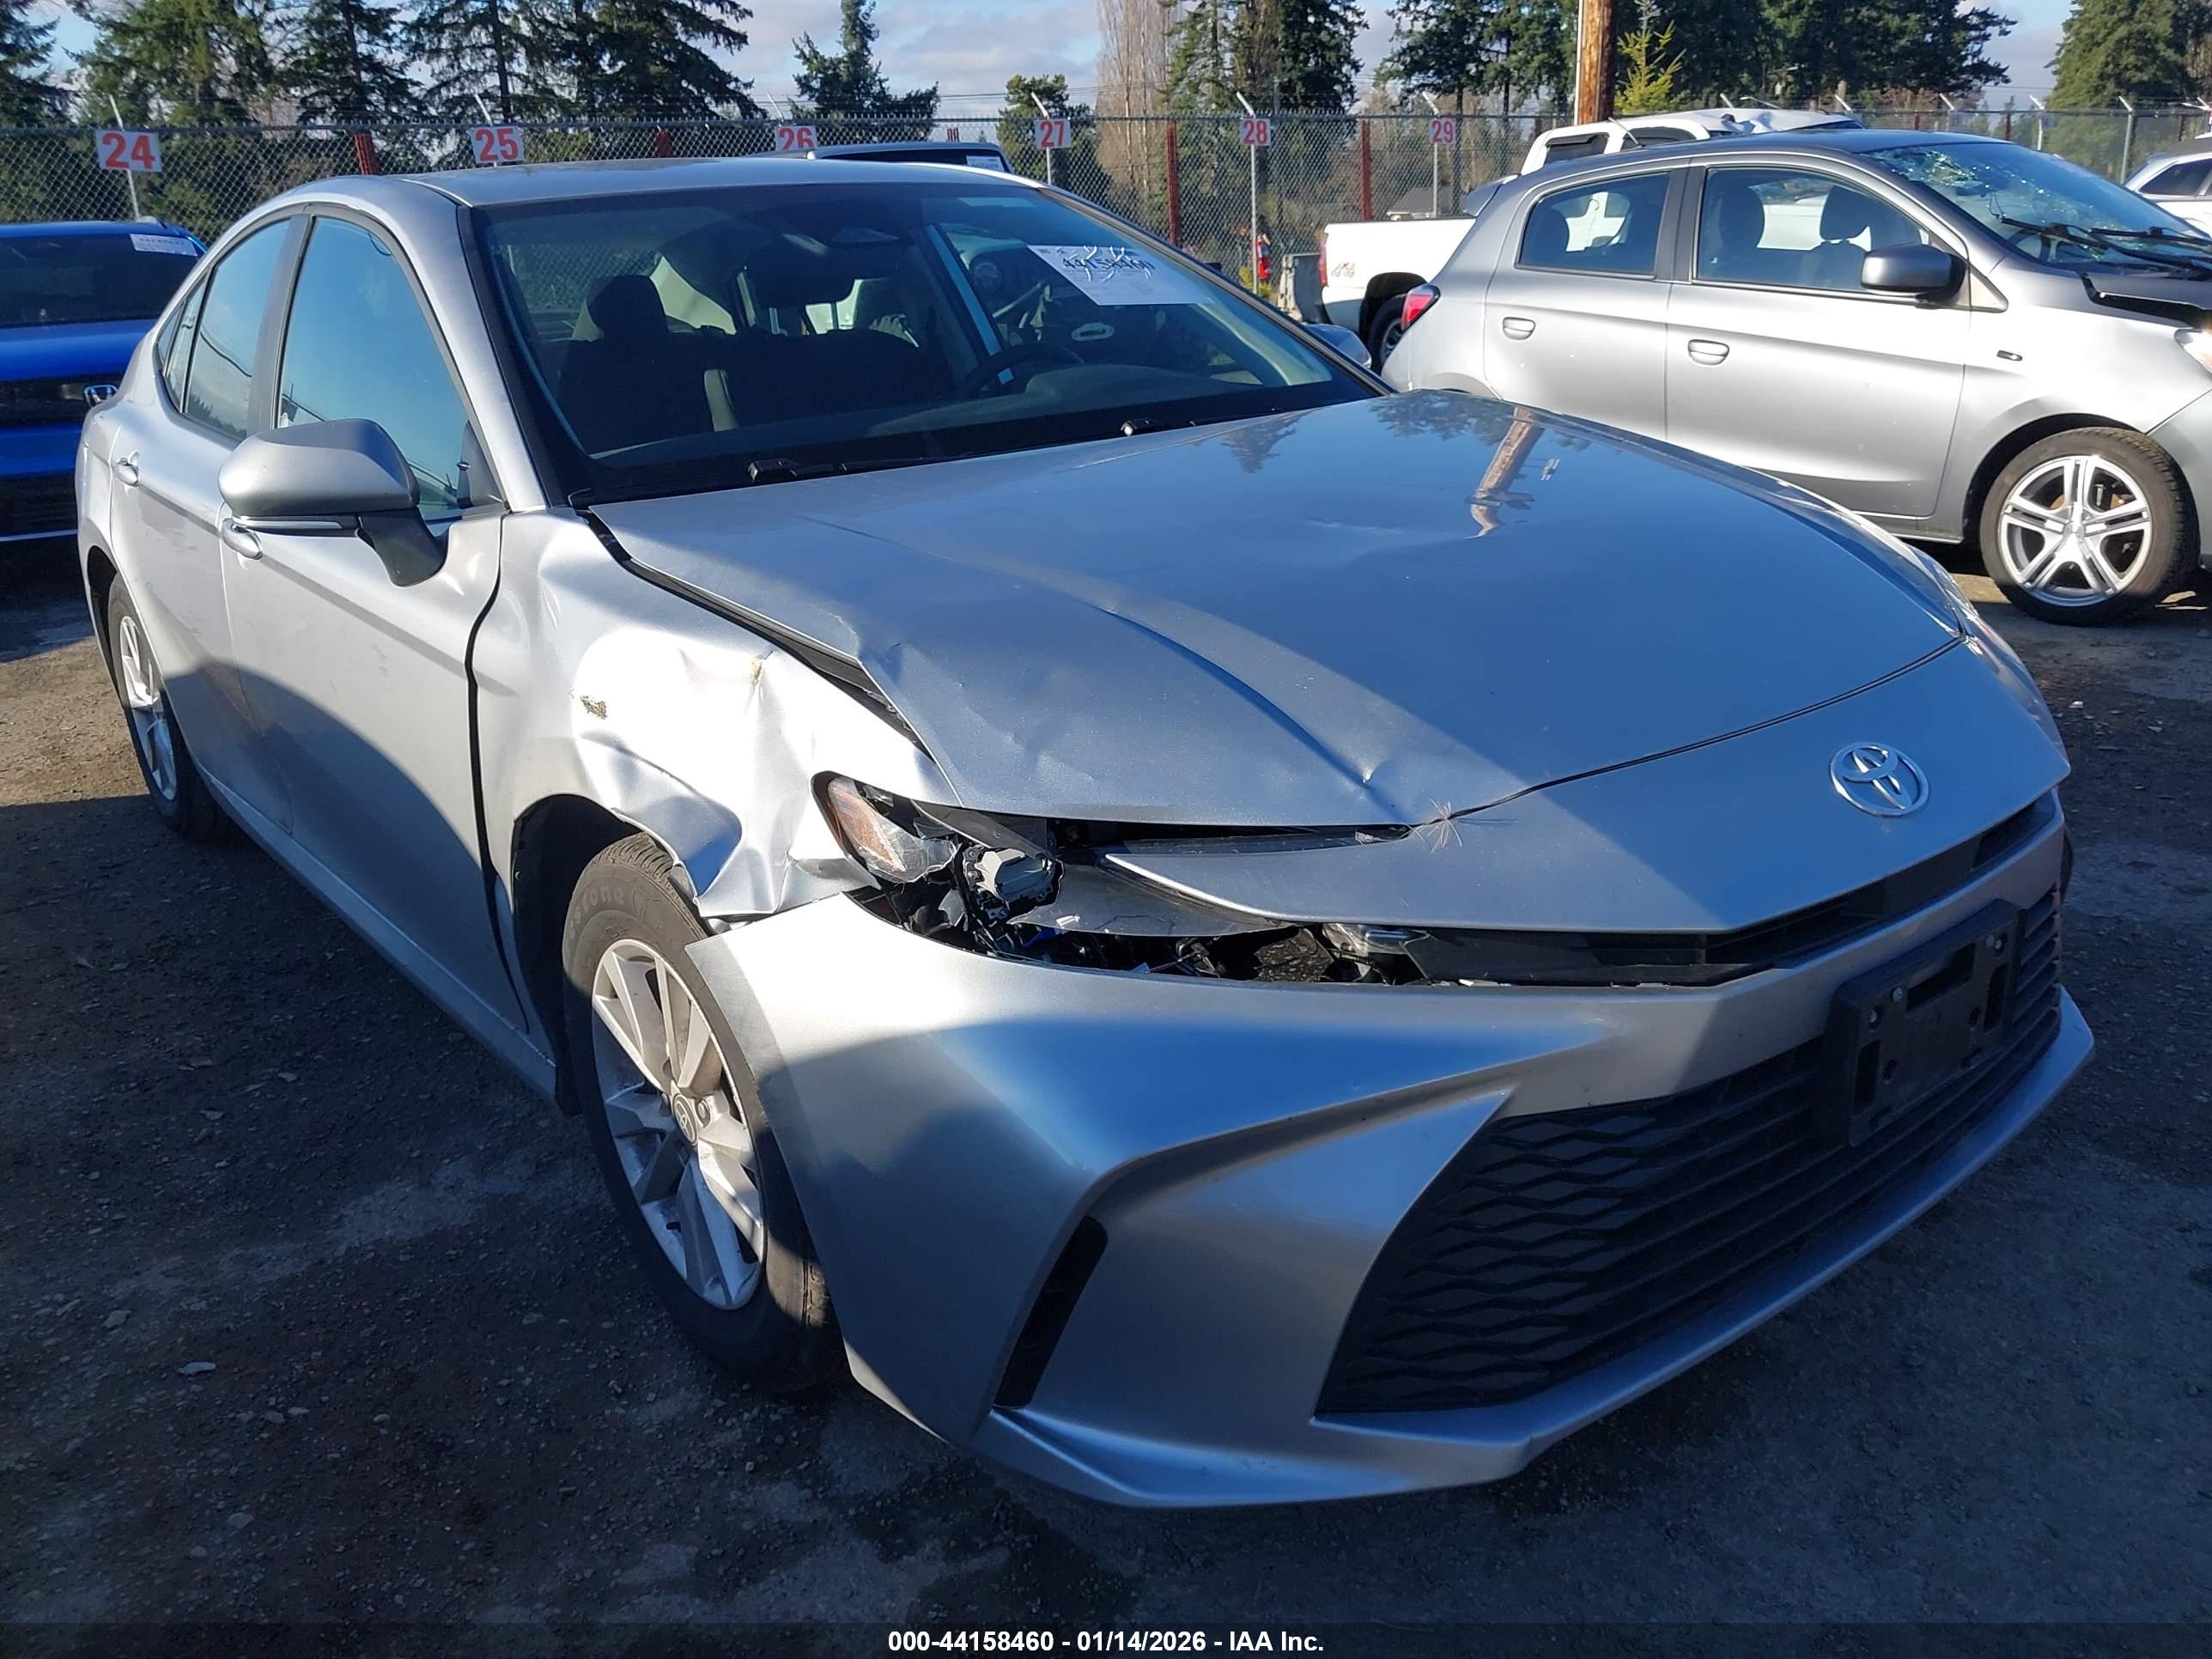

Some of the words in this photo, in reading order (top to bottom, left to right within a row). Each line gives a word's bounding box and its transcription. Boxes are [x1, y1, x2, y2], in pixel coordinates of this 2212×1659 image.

[475, 128, 520, 162] 25
[778, 126, 815, 151] 26
[1039, 120, 1065, 148] 27
[1243, 119, 1268, 145] 28
[1431, 120, 1453, 143] 29
[101, 131, 156, 170] 24
